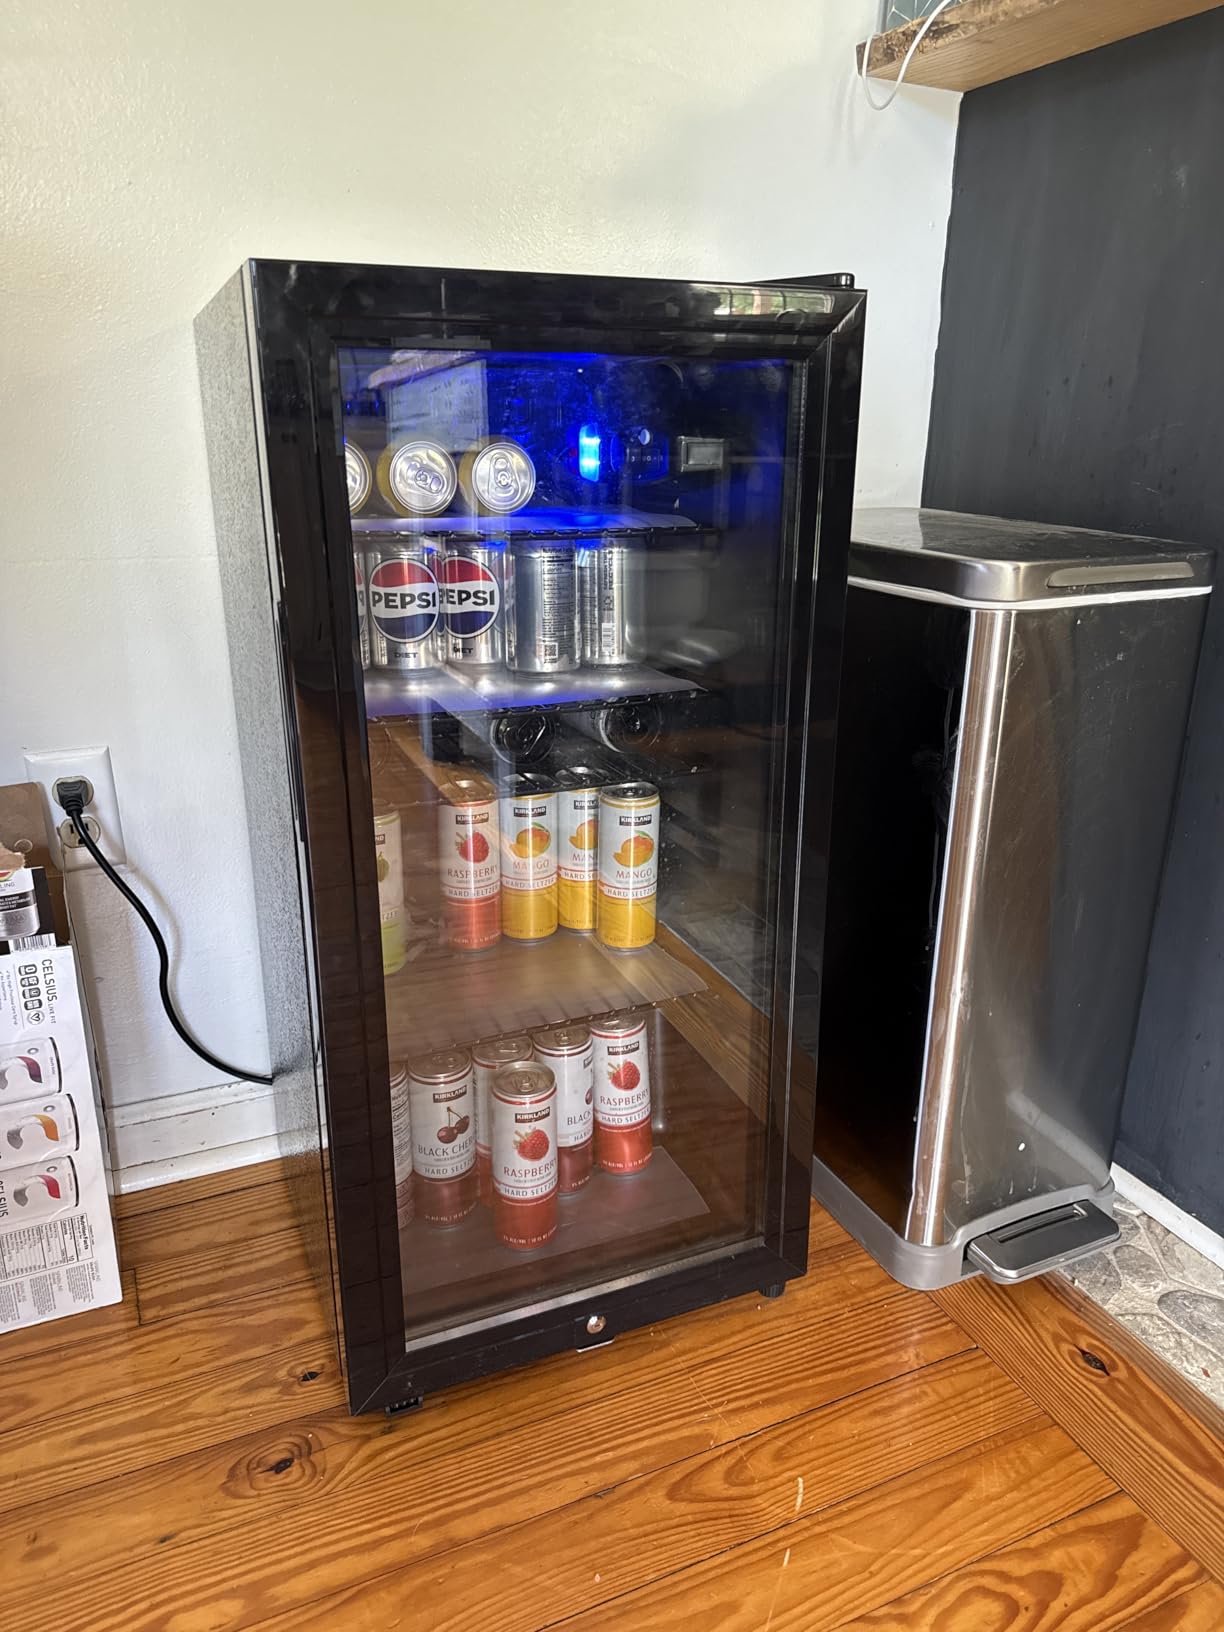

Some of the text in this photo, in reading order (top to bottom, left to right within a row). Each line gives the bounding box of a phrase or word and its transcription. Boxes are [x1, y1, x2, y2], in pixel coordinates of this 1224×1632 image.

[372, 590, 437, 609] PEPSI
[445, 589, 495, 607] EPSI
[394, 651, 418, 659] DIET
[453, 646, 473, 655] DIET
[513, 859, 550, 871] MAGO
[564, 872, 585, 880] HARD
[616, 867, 652, 879] MANGO
[608, 889, 629, 898] HARD
[41, 959, 57, 1002] CELSIUS
[609, 1042, 639, 1052] KIRKLAND
[434, 1087, 467, 1100] KIRKLAND
[600, 1088, 649, 1106] RASPBERRY
[516, 1108, 550, 1120] KIRKLAND
[601, 1115, 622, 1124] HARD
[418, 1145, 449, 1157] BLACK
[424, 1167, 448, 1175] HARD
[504, 1158, 557, 1178] RASPBERRY
[504, 1187, 527, 1197] HARD
